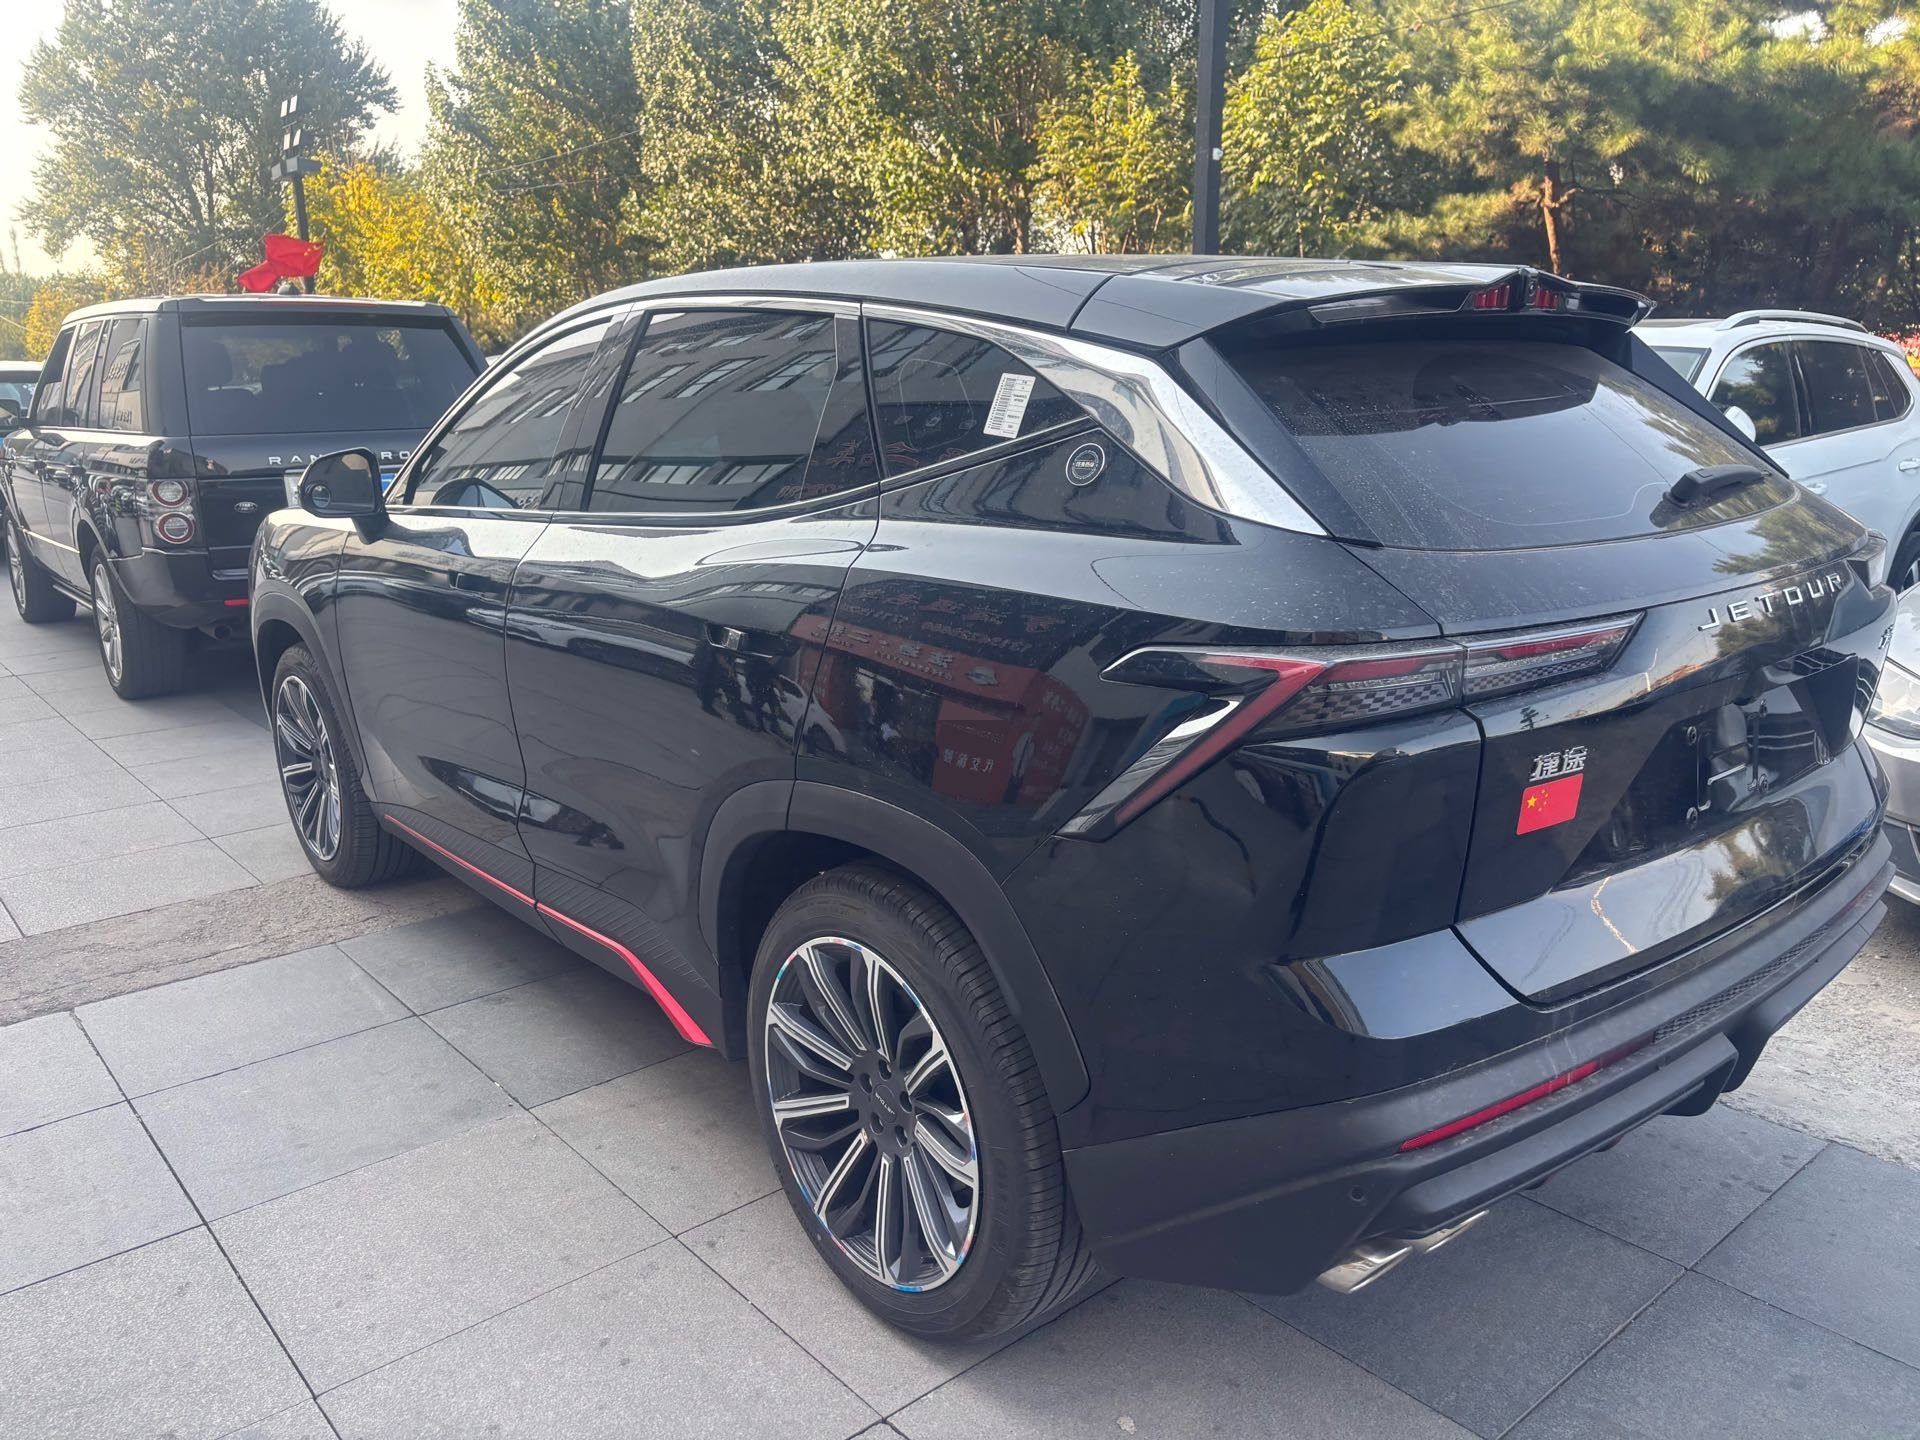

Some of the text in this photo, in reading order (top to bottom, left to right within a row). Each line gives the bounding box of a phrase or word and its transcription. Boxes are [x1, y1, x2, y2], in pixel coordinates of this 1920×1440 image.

[268, 454, 323, 465] RAN
[1697, 572, 1842, 632] JETOUR
[1529, 745, 1588, 782] 捷途
